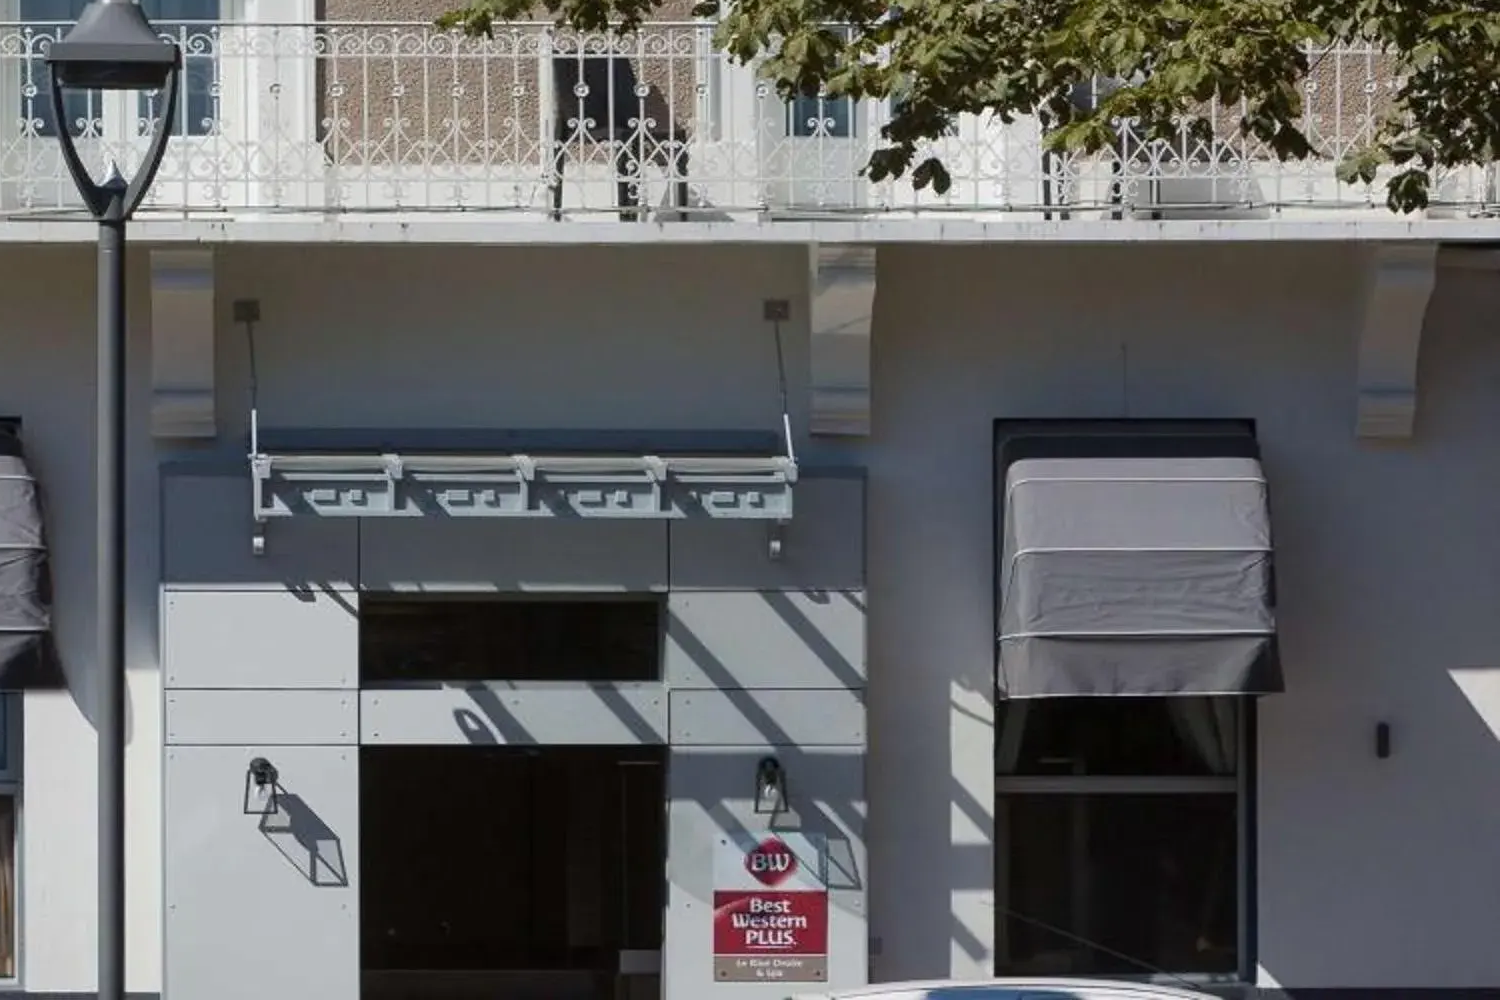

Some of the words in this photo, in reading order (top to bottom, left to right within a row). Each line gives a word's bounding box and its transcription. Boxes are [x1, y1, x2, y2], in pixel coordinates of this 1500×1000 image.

[751, 853, 789, 872] BW
[750, 897, 791, 913] Best
[732, 912, 807, 929] Western
